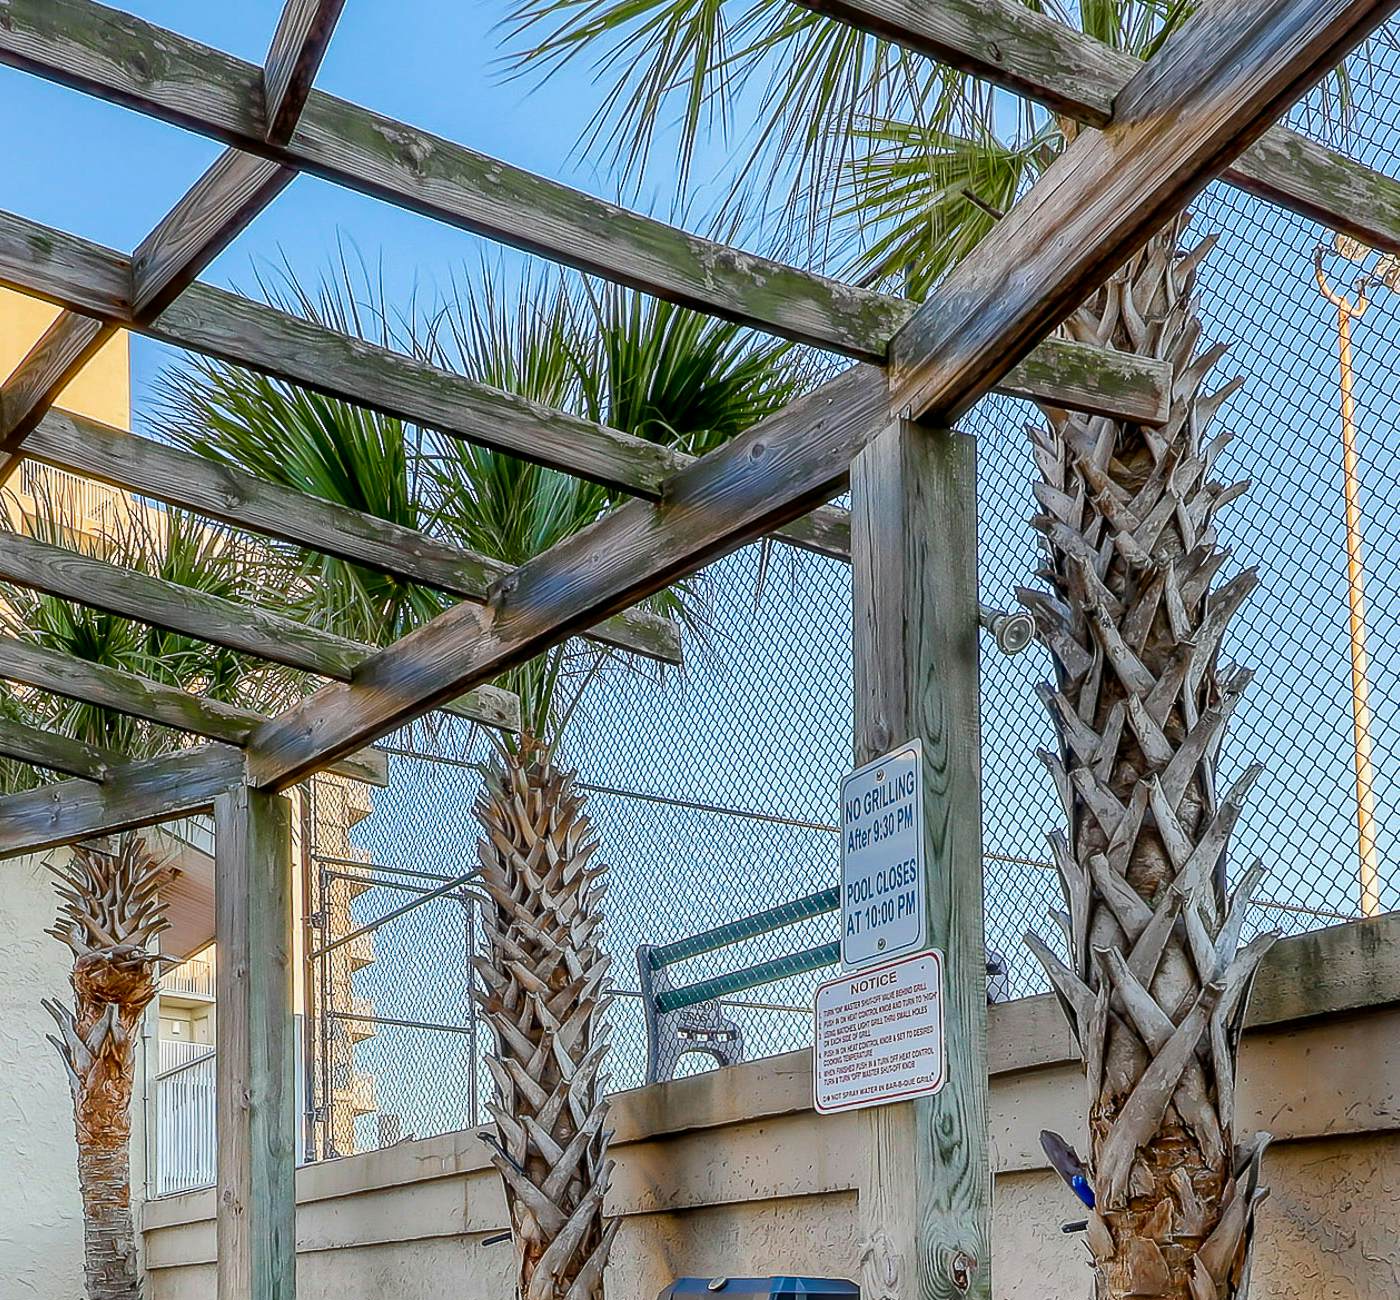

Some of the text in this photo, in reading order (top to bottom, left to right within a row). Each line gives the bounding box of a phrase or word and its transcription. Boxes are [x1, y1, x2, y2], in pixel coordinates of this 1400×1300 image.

[845, 770, 914, 825] NO GRILLING
[847, 803, 913, 854] After 9:30 PM
[847, 858, 917, 907] POOL CLOSES
[846, 890, 916, 937] AT 10:00 PM
[850, 971, 897, 995] NOTICE
[912, 1005, 927, 1016] HOLES
